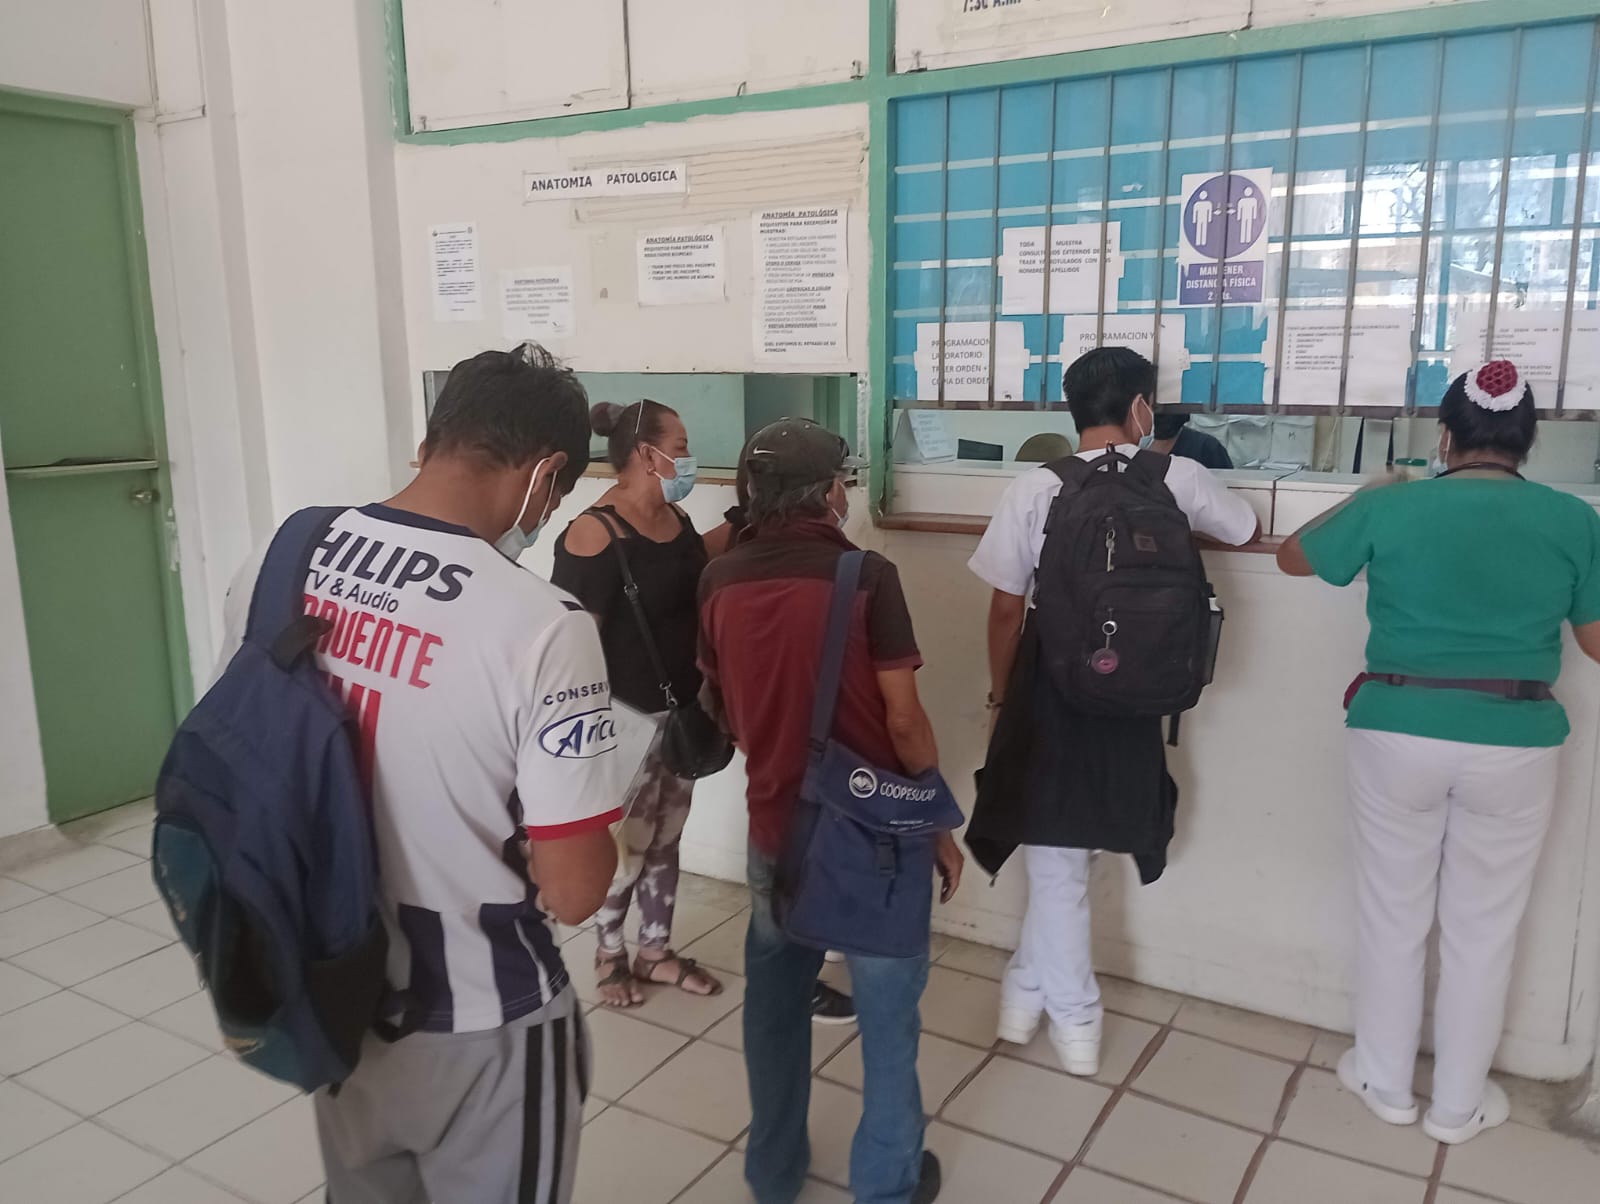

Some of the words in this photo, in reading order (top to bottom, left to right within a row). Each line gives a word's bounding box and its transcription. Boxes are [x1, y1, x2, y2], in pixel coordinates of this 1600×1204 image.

[531, 176, 592, 191] ANATOMIA
[606, 170, 677, 184] PATOLOGICA
[1200, 264, 1243, 276] MANENER
[1208, 291, 1213, 300] 2
[329, 577, 345, 597] &
[345, 583, 400, 614] Audio
